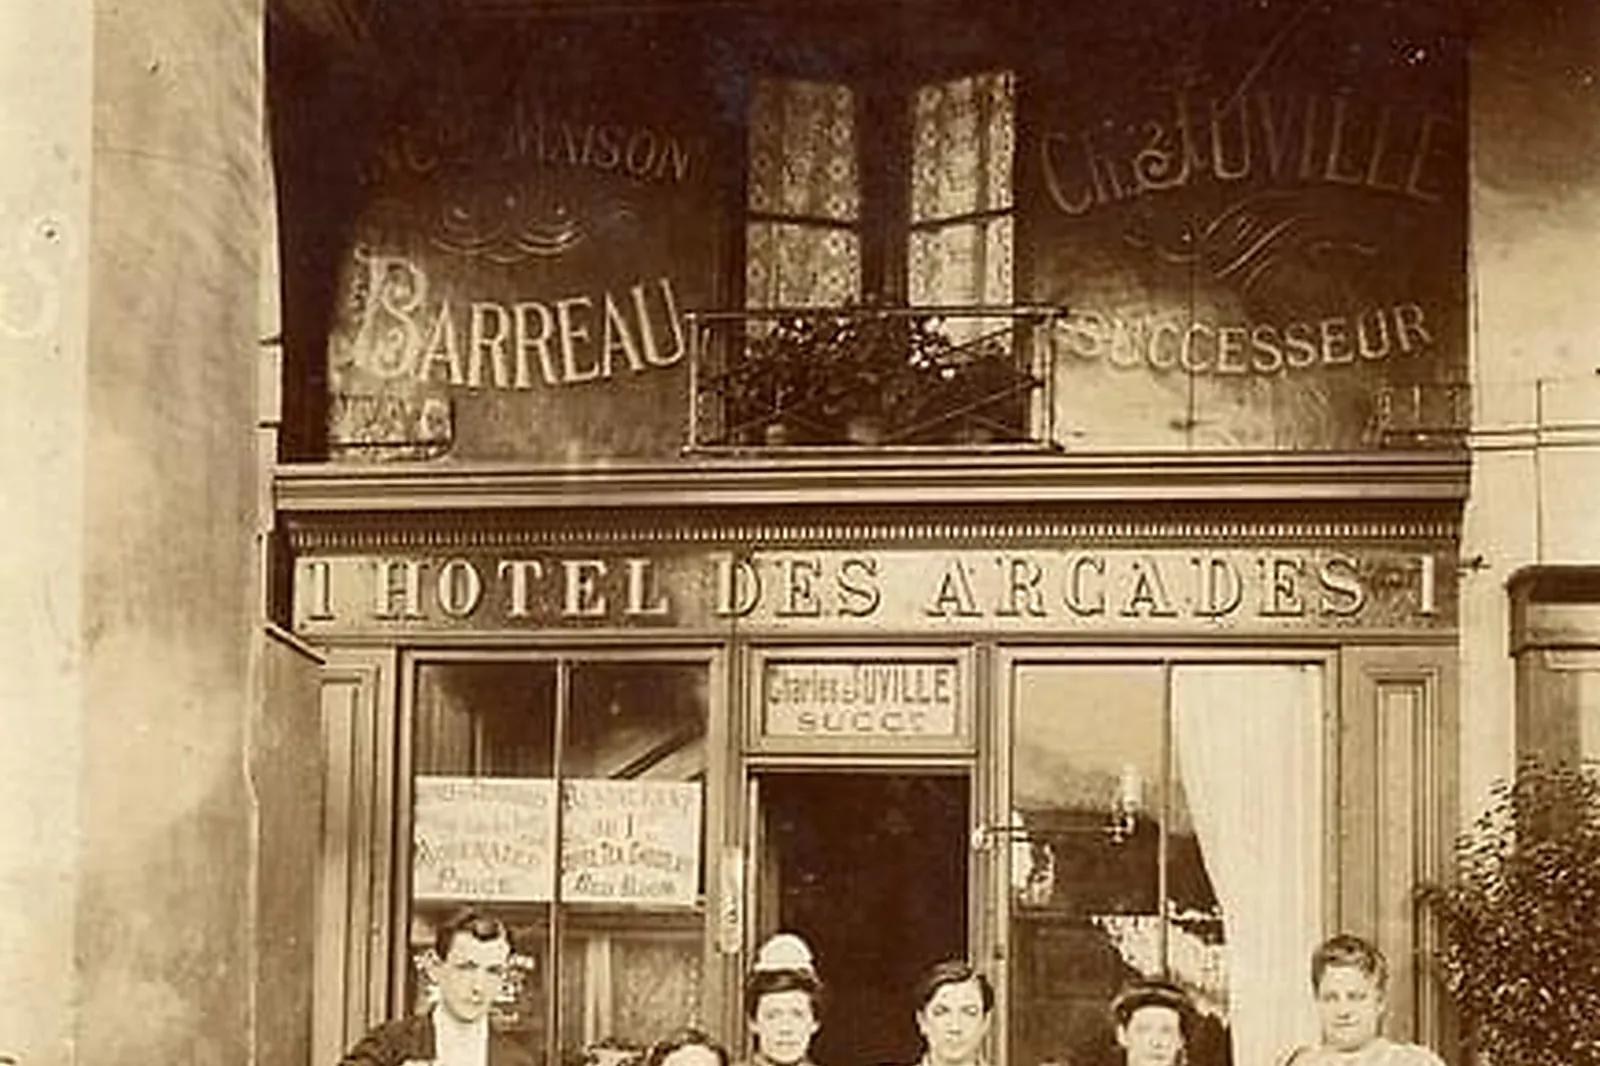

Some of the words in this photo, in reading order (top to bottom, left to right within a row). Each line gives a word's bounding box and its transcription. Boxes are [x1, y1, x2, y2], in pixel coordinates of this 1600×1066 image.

[353, 246, 686, 389] BARREAU
[1056, 302, 1432, 375] SUCCESSEUR
[376, 557, 670, 620] HOTEL
[717, 557, 881, 618] DES
[925, 553, 1367, 619] ARCADES
